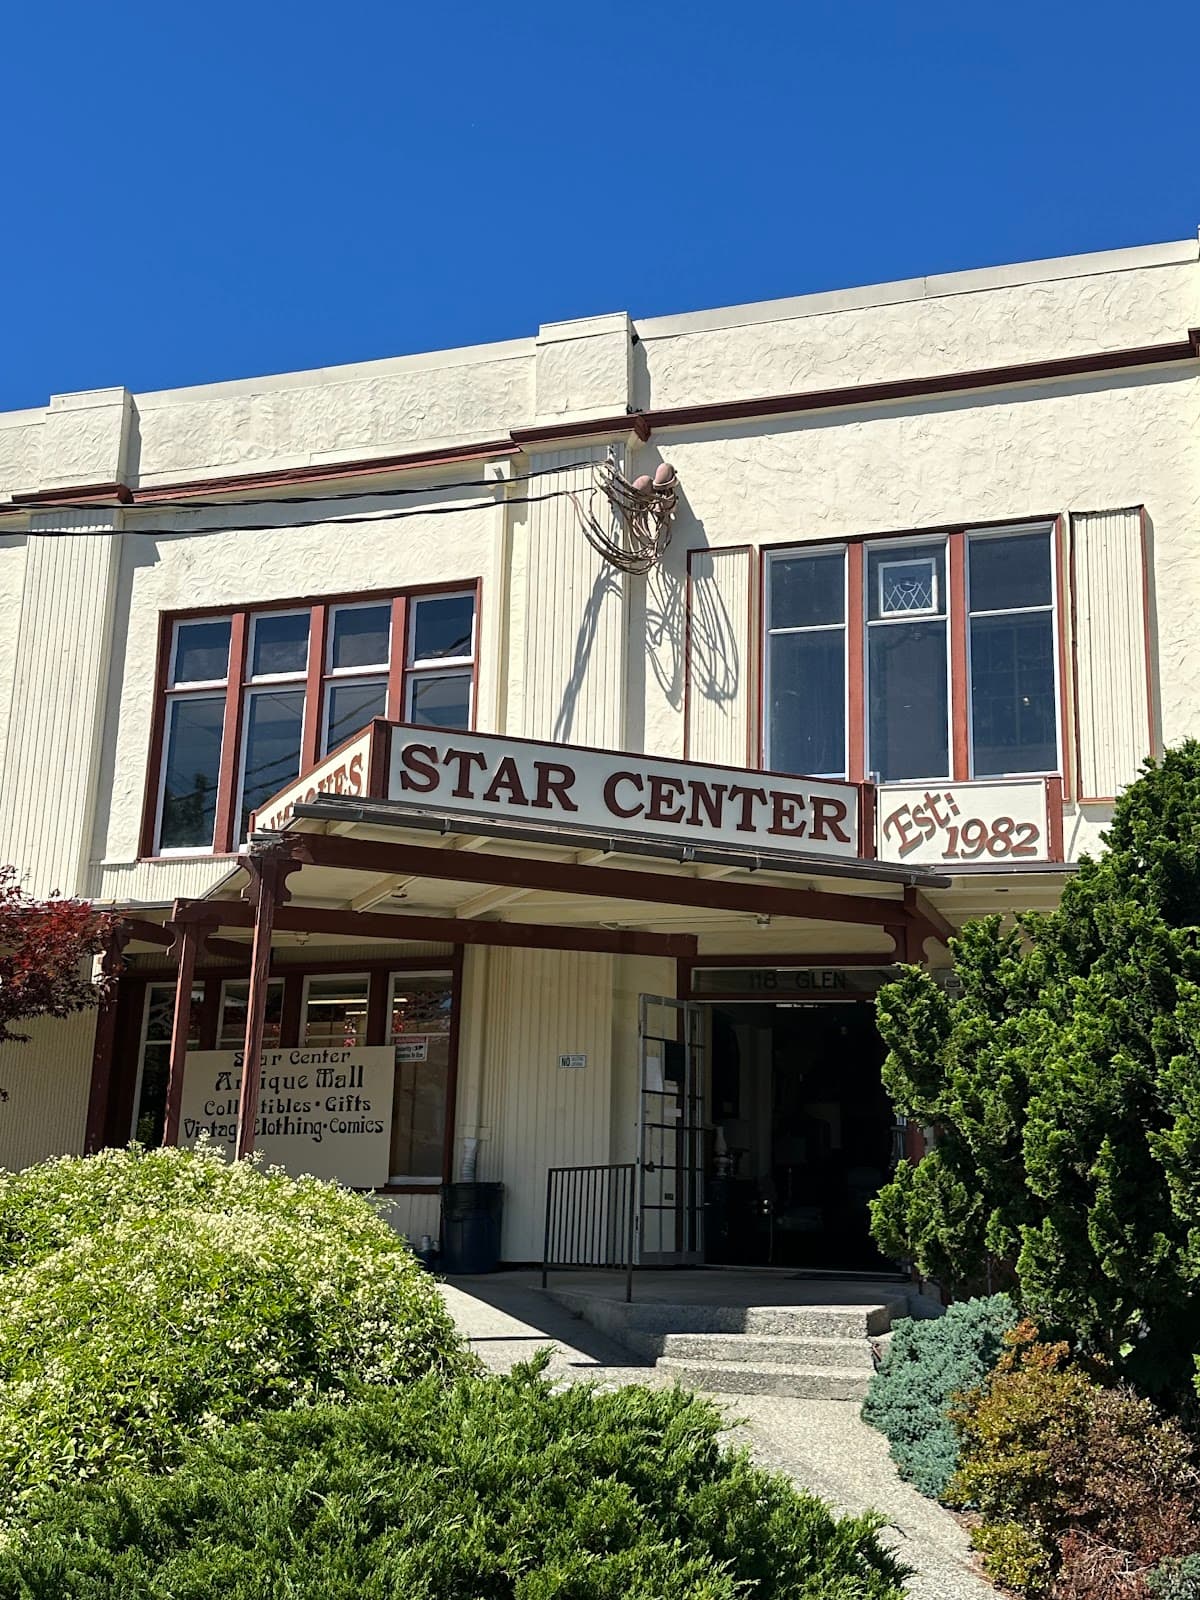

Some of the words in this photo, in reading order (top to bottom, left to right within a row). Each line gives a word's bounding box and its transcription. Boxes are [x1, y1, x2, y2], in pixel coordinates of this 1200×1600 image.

[399, 743, 579, 812] STAR
[603, 771, 851, 843] CENTER
[941, 816, 1040, 860] 1982
[750, 972, 778, 989] 118
[795, 972, 847, 989] GLEN
[233, 1052, 282, 1067] Sar
[290, 1049, 351, 1065] Center
[216, 1071, 308, 1094] Aique
[316, 1065, 364, 1089] Mall
[204, 1099, 311, 1116] Colltibles
[325, 1094, 372, 1113] Gifts
[184, 1118, 238, 1143] Vintag
[330, 1116, 384, 1134] Comics
